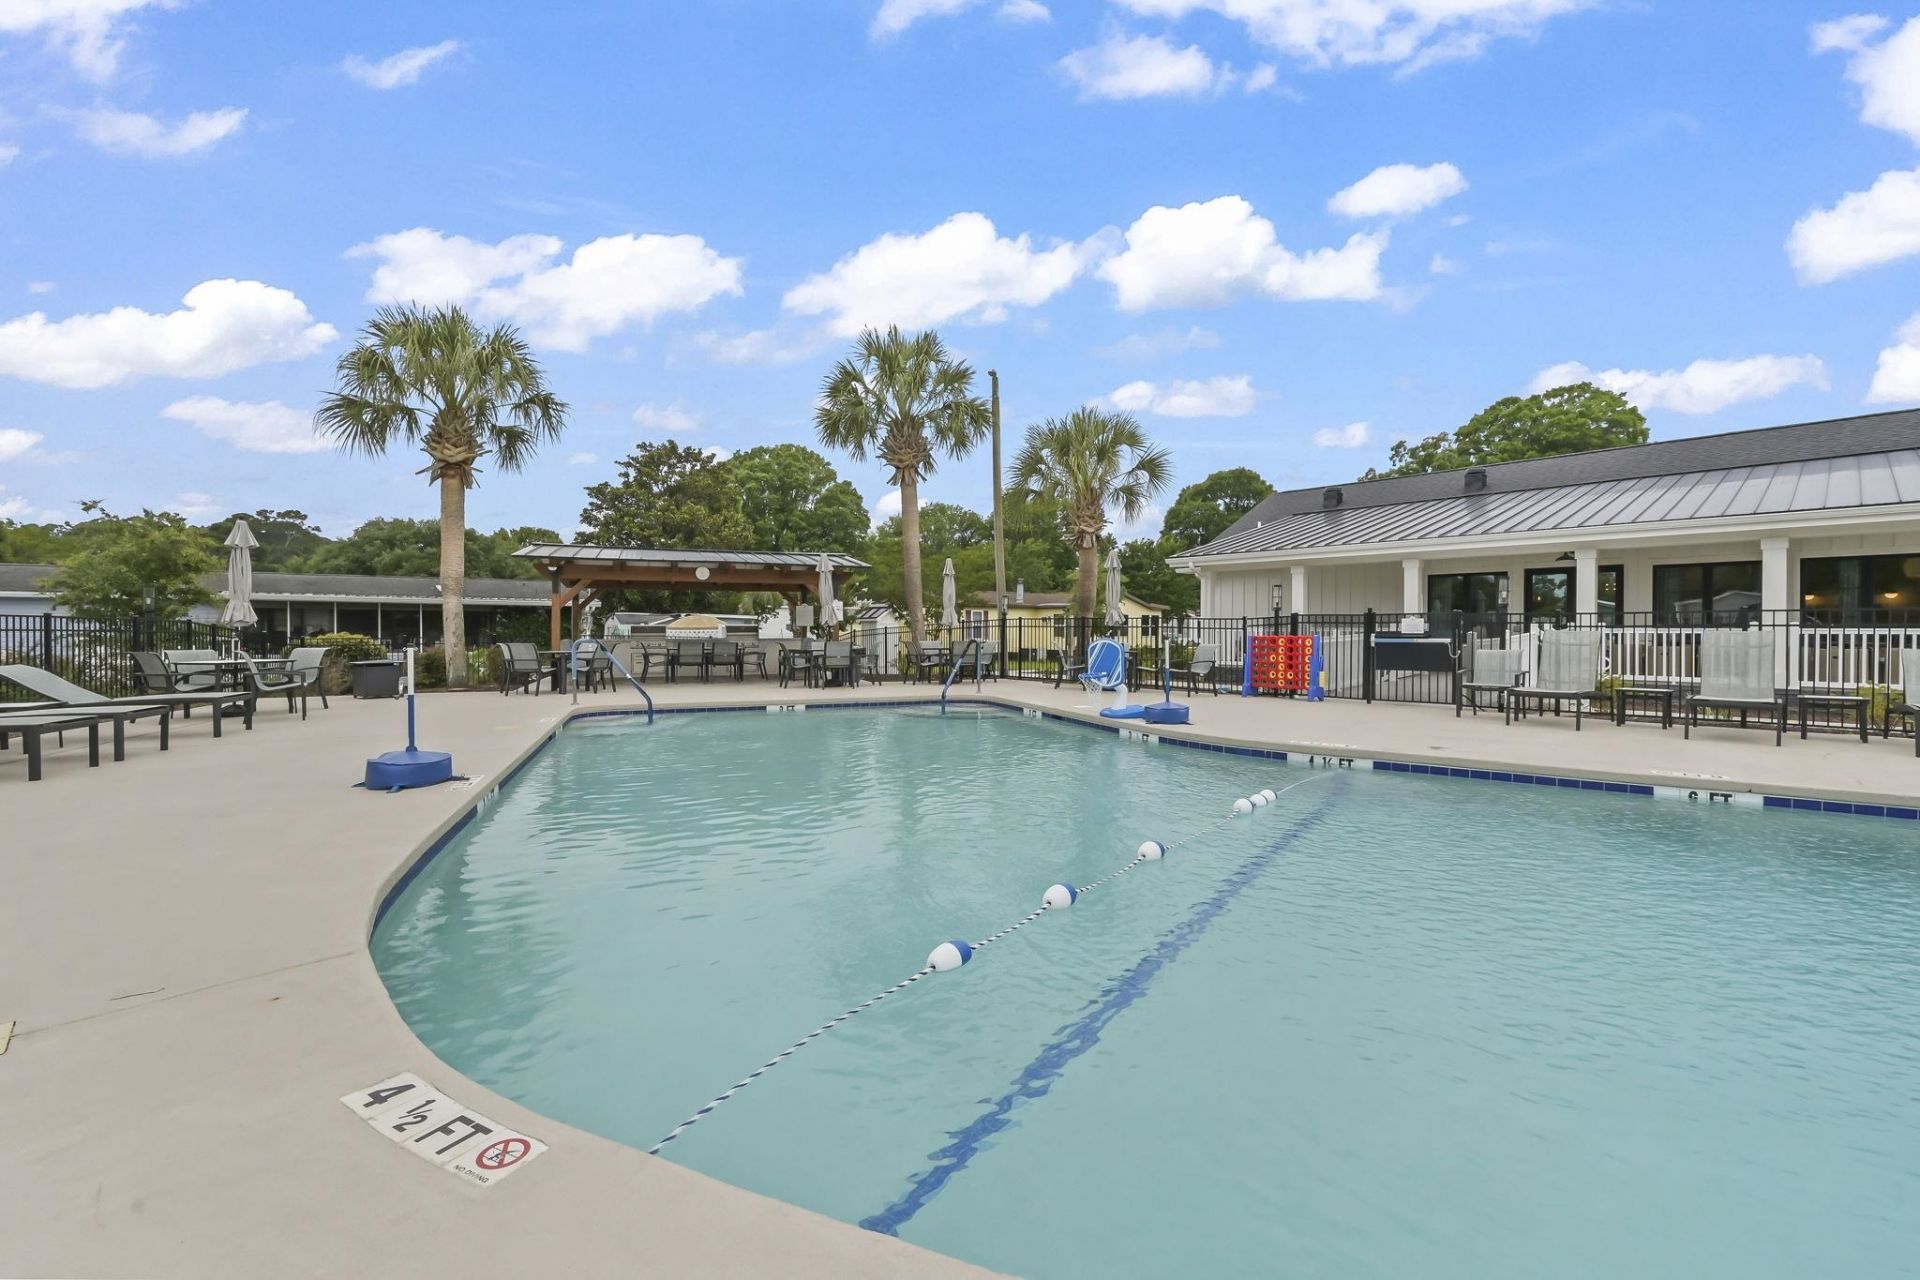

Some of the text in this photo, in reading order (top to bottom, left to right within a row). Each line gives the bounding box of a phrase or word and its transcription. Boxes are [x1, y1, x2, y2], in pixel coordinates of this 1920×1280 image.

[362, 1083, 417, 1109] 4
[413, 1114, 494, 1156] FT
[454, 1164, 466, 1172] NO
